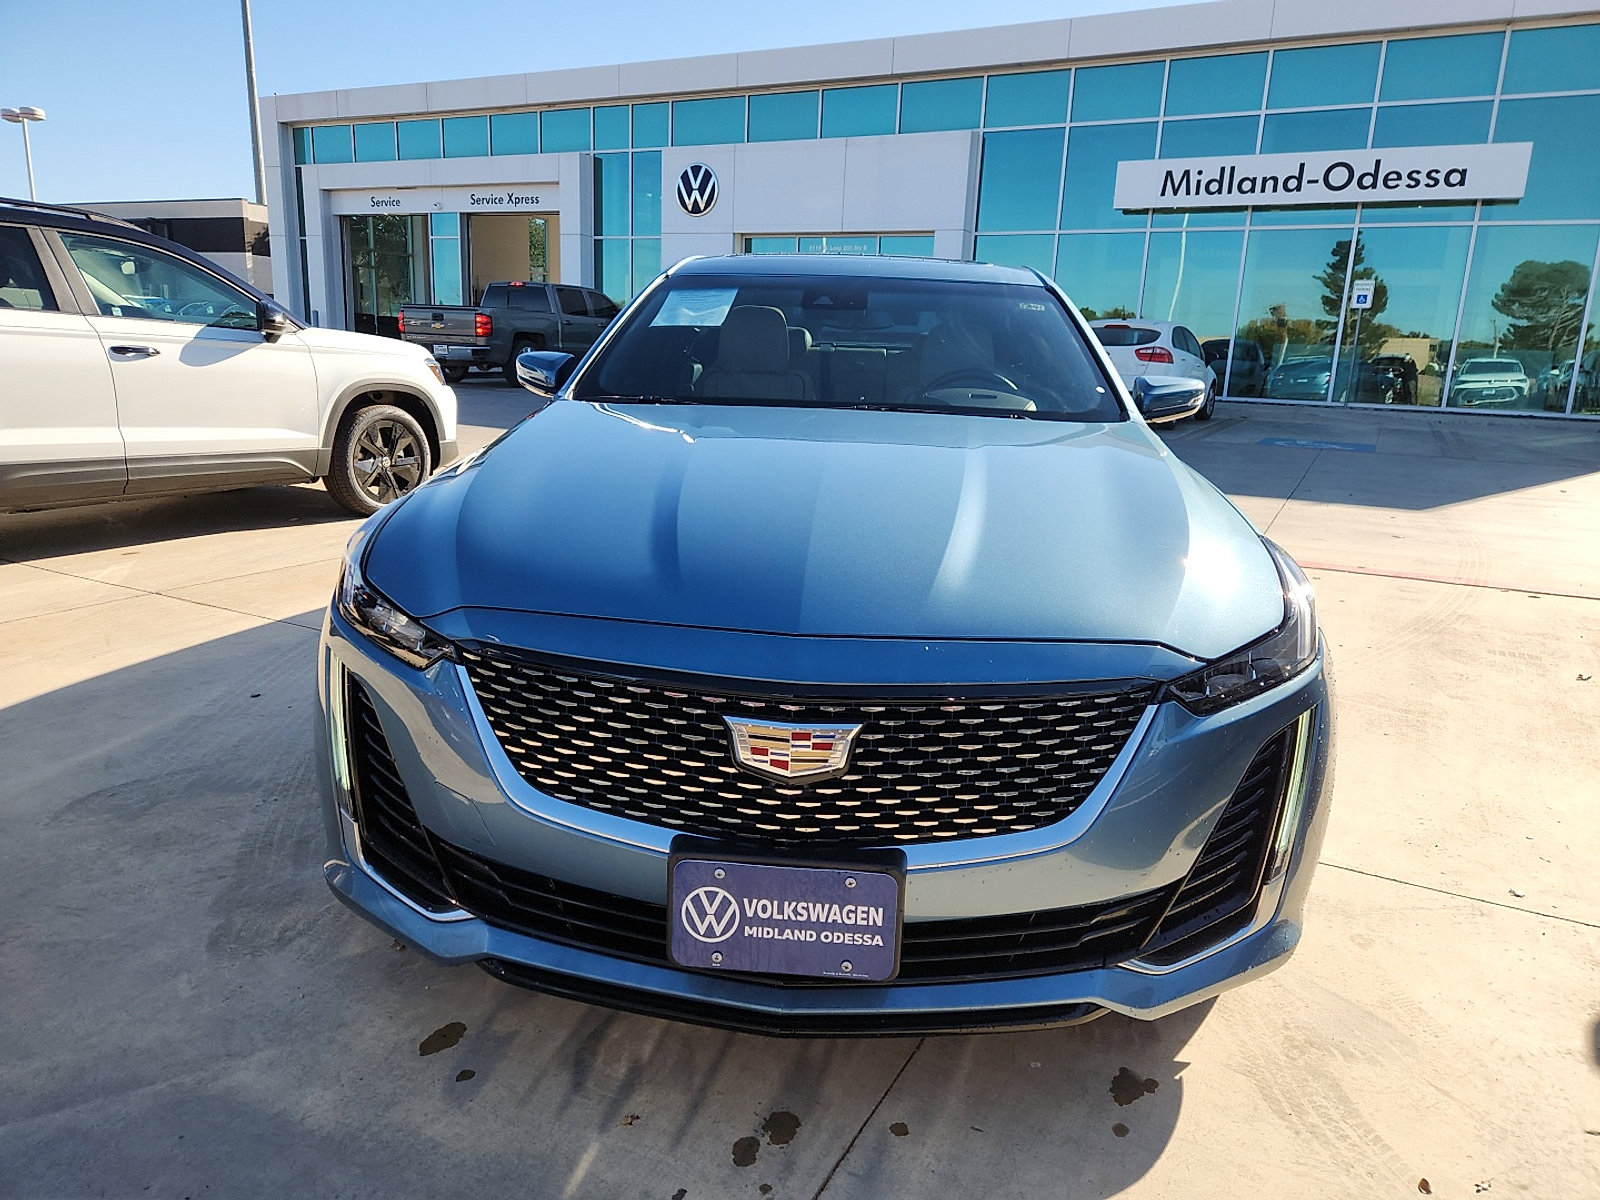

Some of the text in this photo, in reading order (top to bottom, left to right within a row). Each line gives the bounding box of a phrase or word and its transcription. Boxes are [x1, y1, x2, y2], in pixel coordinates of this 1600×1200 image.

[677, 163, 718, 216] VW
[1160, 159, 1468, 197] Midland-Odessa
[370, 196, 401, 207] Service
[470, 192, 540, 207] Service Xpress
[682, 886, 741, 943] VW
[743, 898, 884, 927] VOLKSWAGEN
[744, 926, 884, 947] MIDLAND ODESSA
